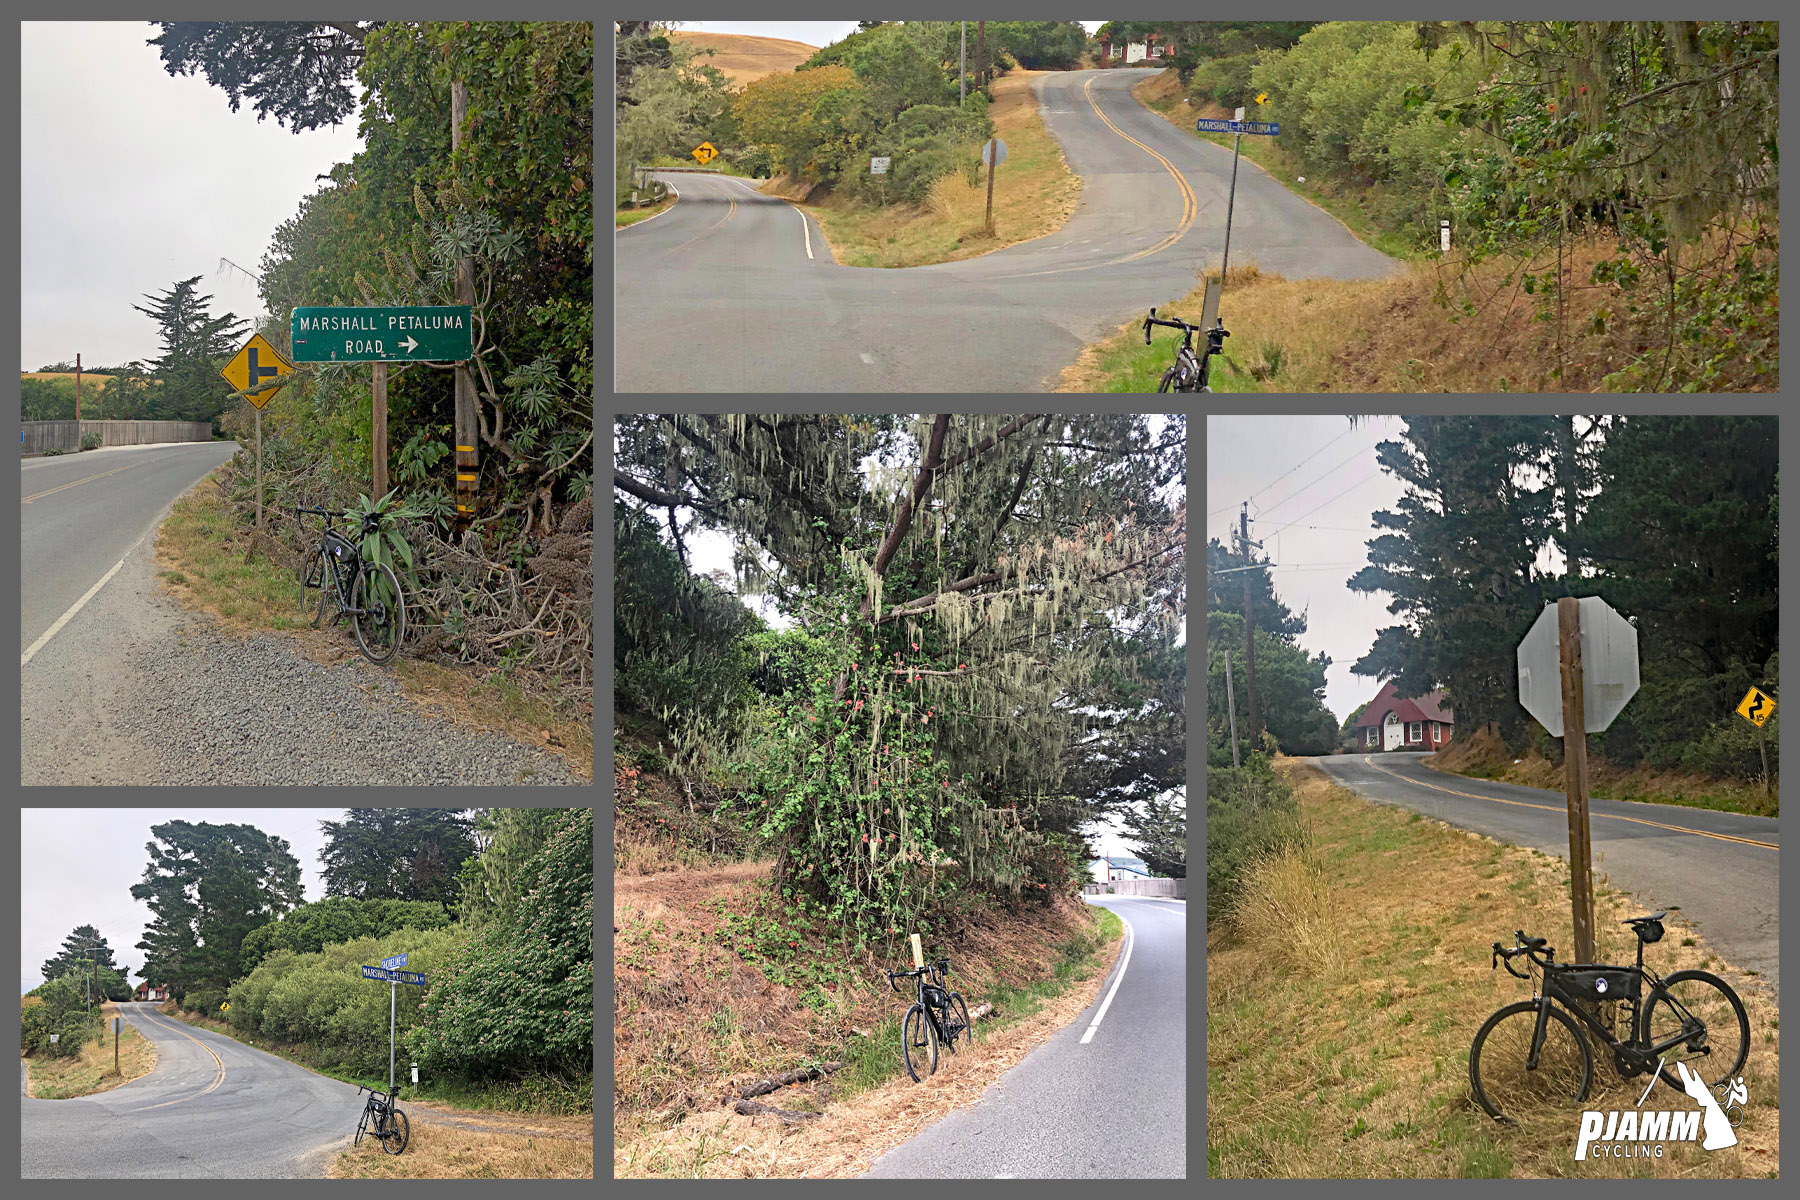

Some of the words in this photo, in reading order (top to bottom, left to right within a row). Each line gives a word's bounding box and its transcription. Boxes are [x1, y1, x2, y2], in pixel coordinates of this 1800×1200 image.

[300, 316, 377, 331] MARSHALL
[388, 315, 463, 330] PETALUMA
[345, 339, 383, 354] ROAD
[1756, 713, 1765, 722] 15
